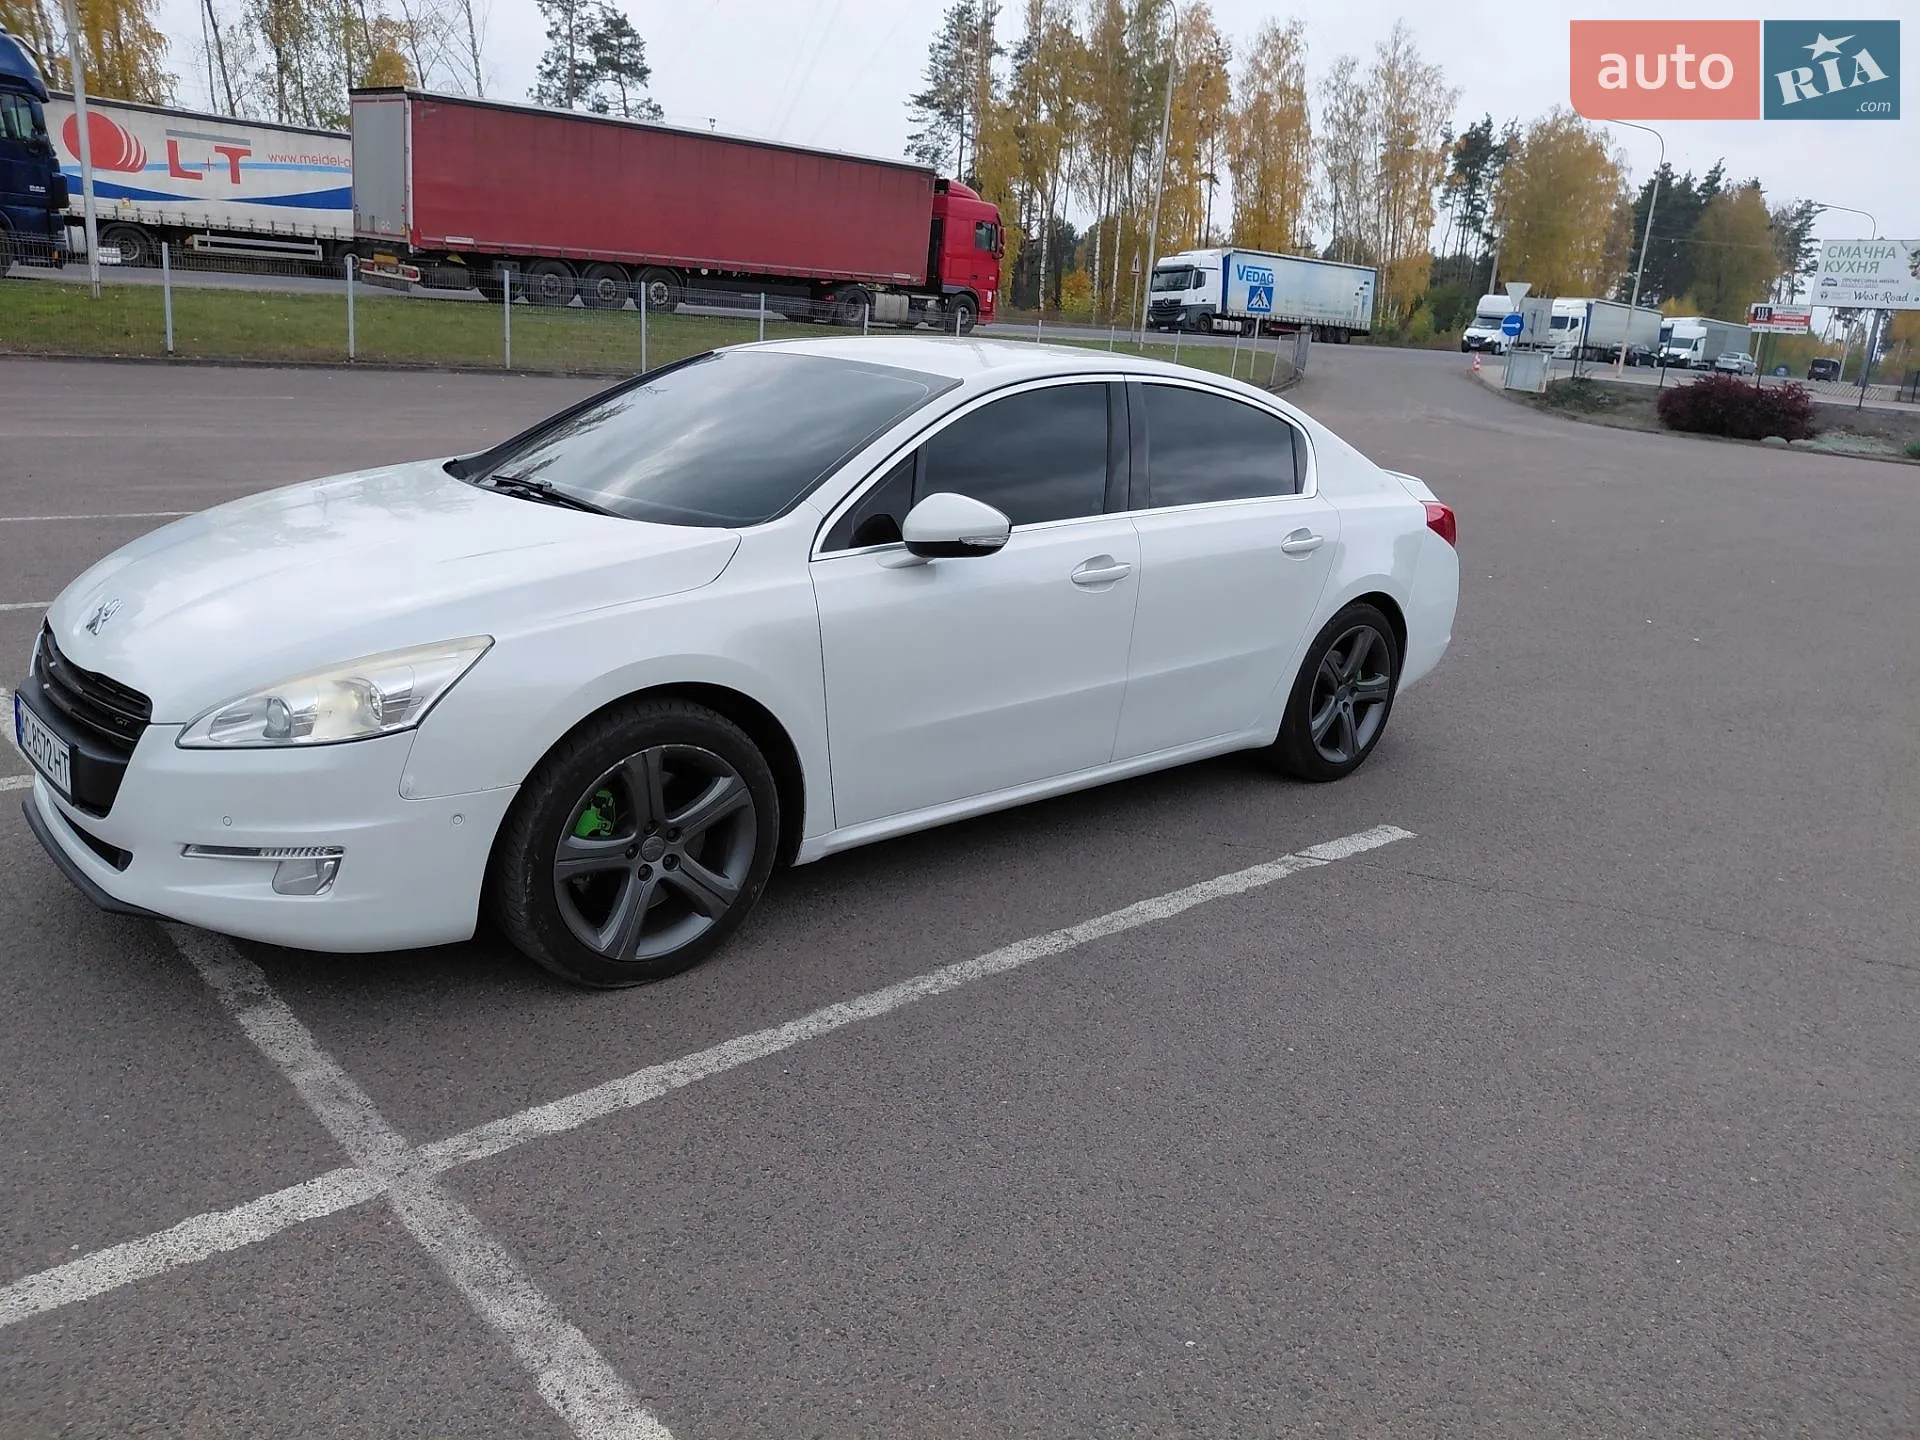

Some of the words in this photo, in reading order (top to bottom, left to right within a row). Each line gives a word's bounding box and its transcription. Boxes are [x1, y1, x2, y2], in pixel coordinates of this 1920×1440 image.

[1827, 245, 1897, 259] СМАЧНА
[1237, 263, 1274, 285] VEDAG
[1823, 260, 1881, 274] КУХНЯ
[1854, 290, 1878, 301] West
[1879, 292, 1909, 304] Road
